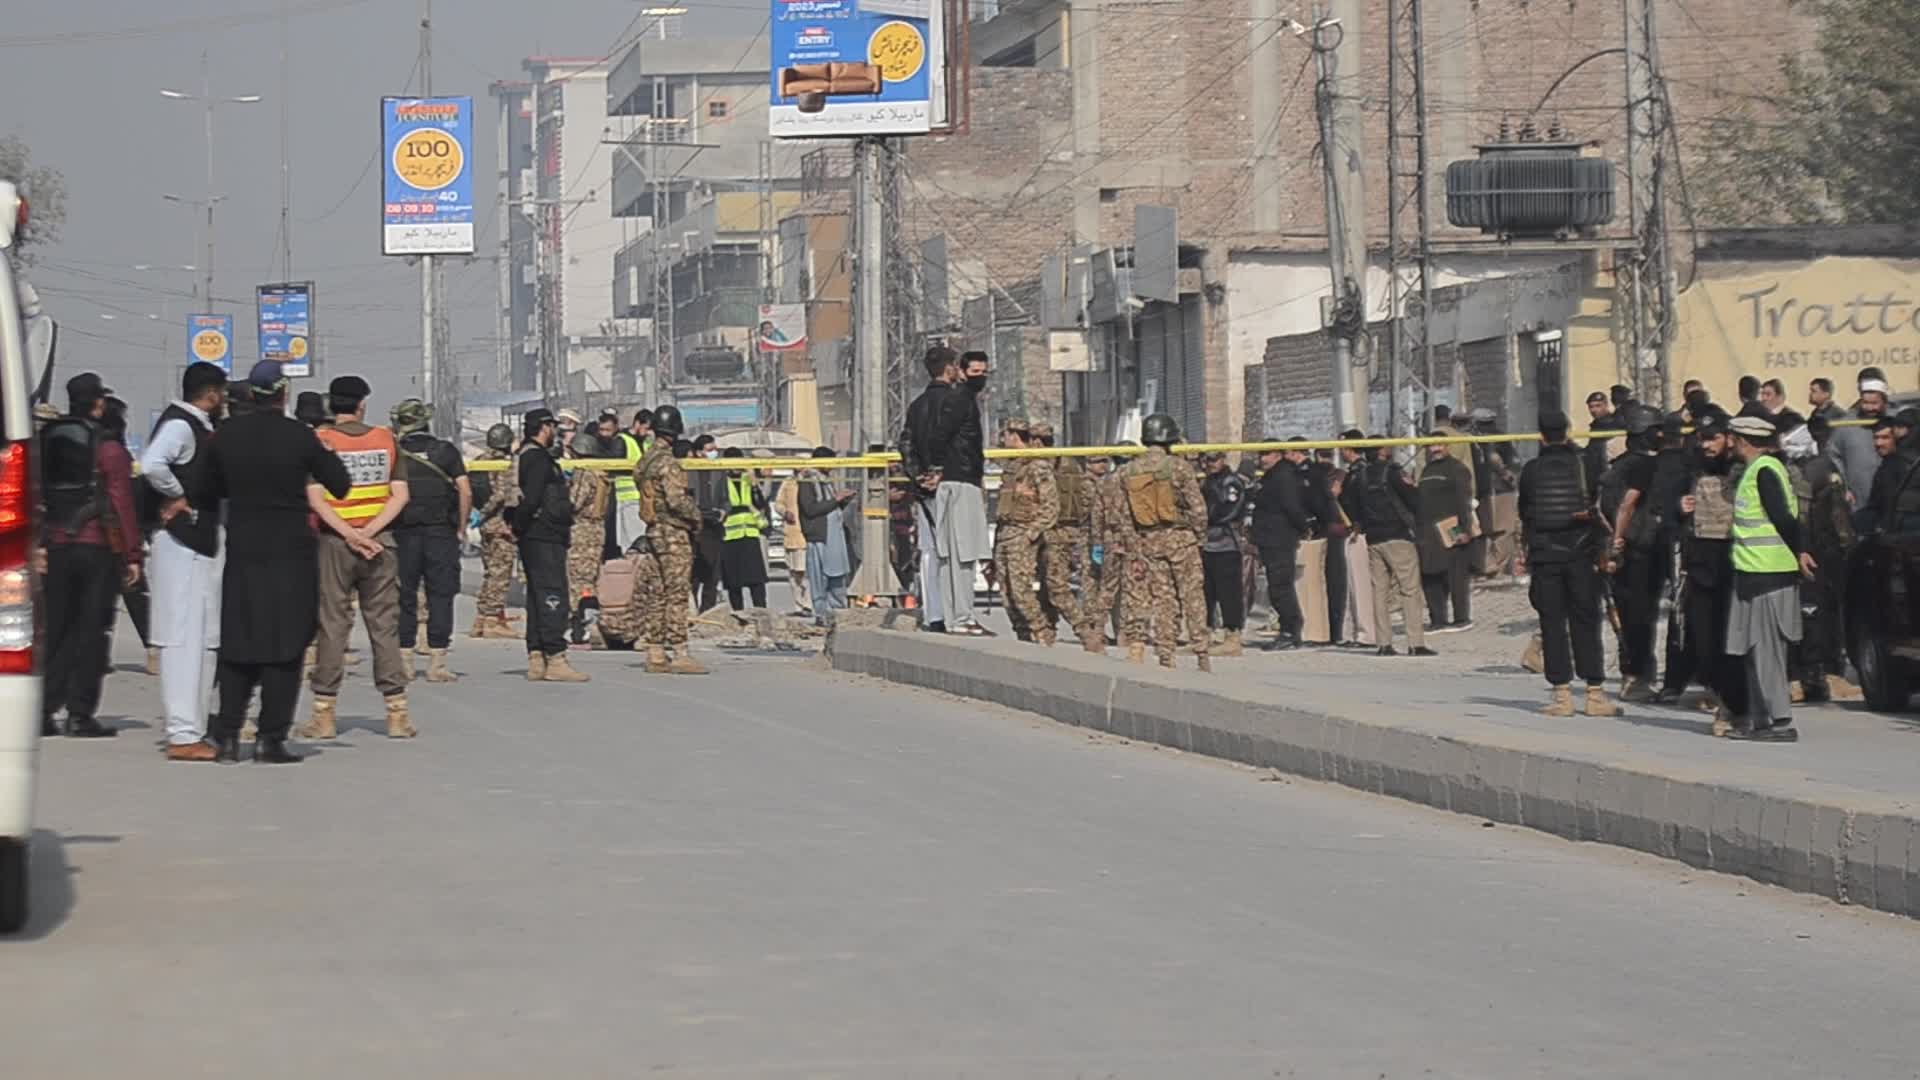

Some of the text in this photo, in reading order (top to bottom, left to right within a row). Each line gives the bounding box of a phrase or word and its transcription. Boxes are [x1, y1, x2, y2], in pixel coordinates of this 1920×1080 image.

[798, 36, 831, 45] ENTRY
[406, 140, 450, 158] 100
[439, 191, 459, 203] 40
[1765, 351, 1810, 368] FAST
